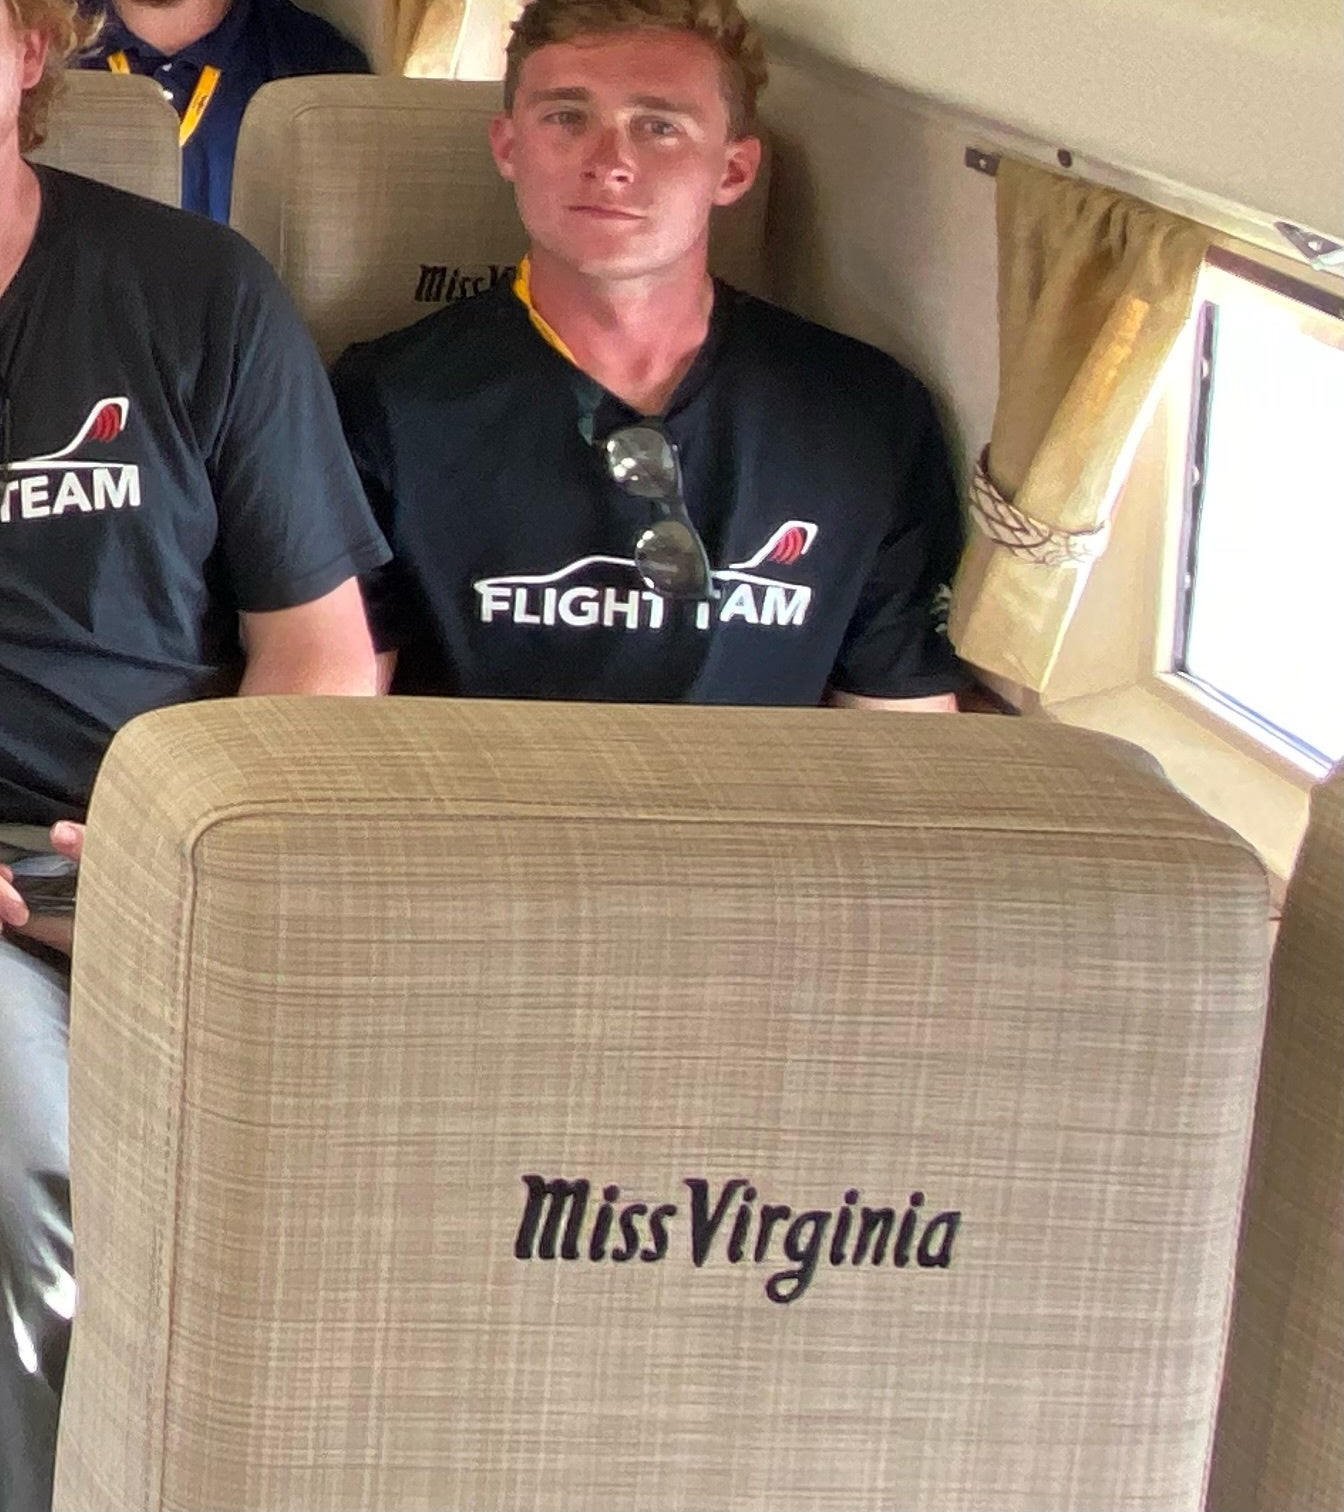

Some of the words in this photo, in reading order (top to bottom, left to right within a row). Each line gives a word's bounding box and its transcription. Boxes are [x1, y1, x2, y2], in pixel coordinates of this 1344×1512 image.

[0, 466, 141, 523] TEAM
[479, 586, 665, 630] FLIGHT
[514, 1175, 677, 1263] Miss
[683, 1177, 962, 1304] Virginia
